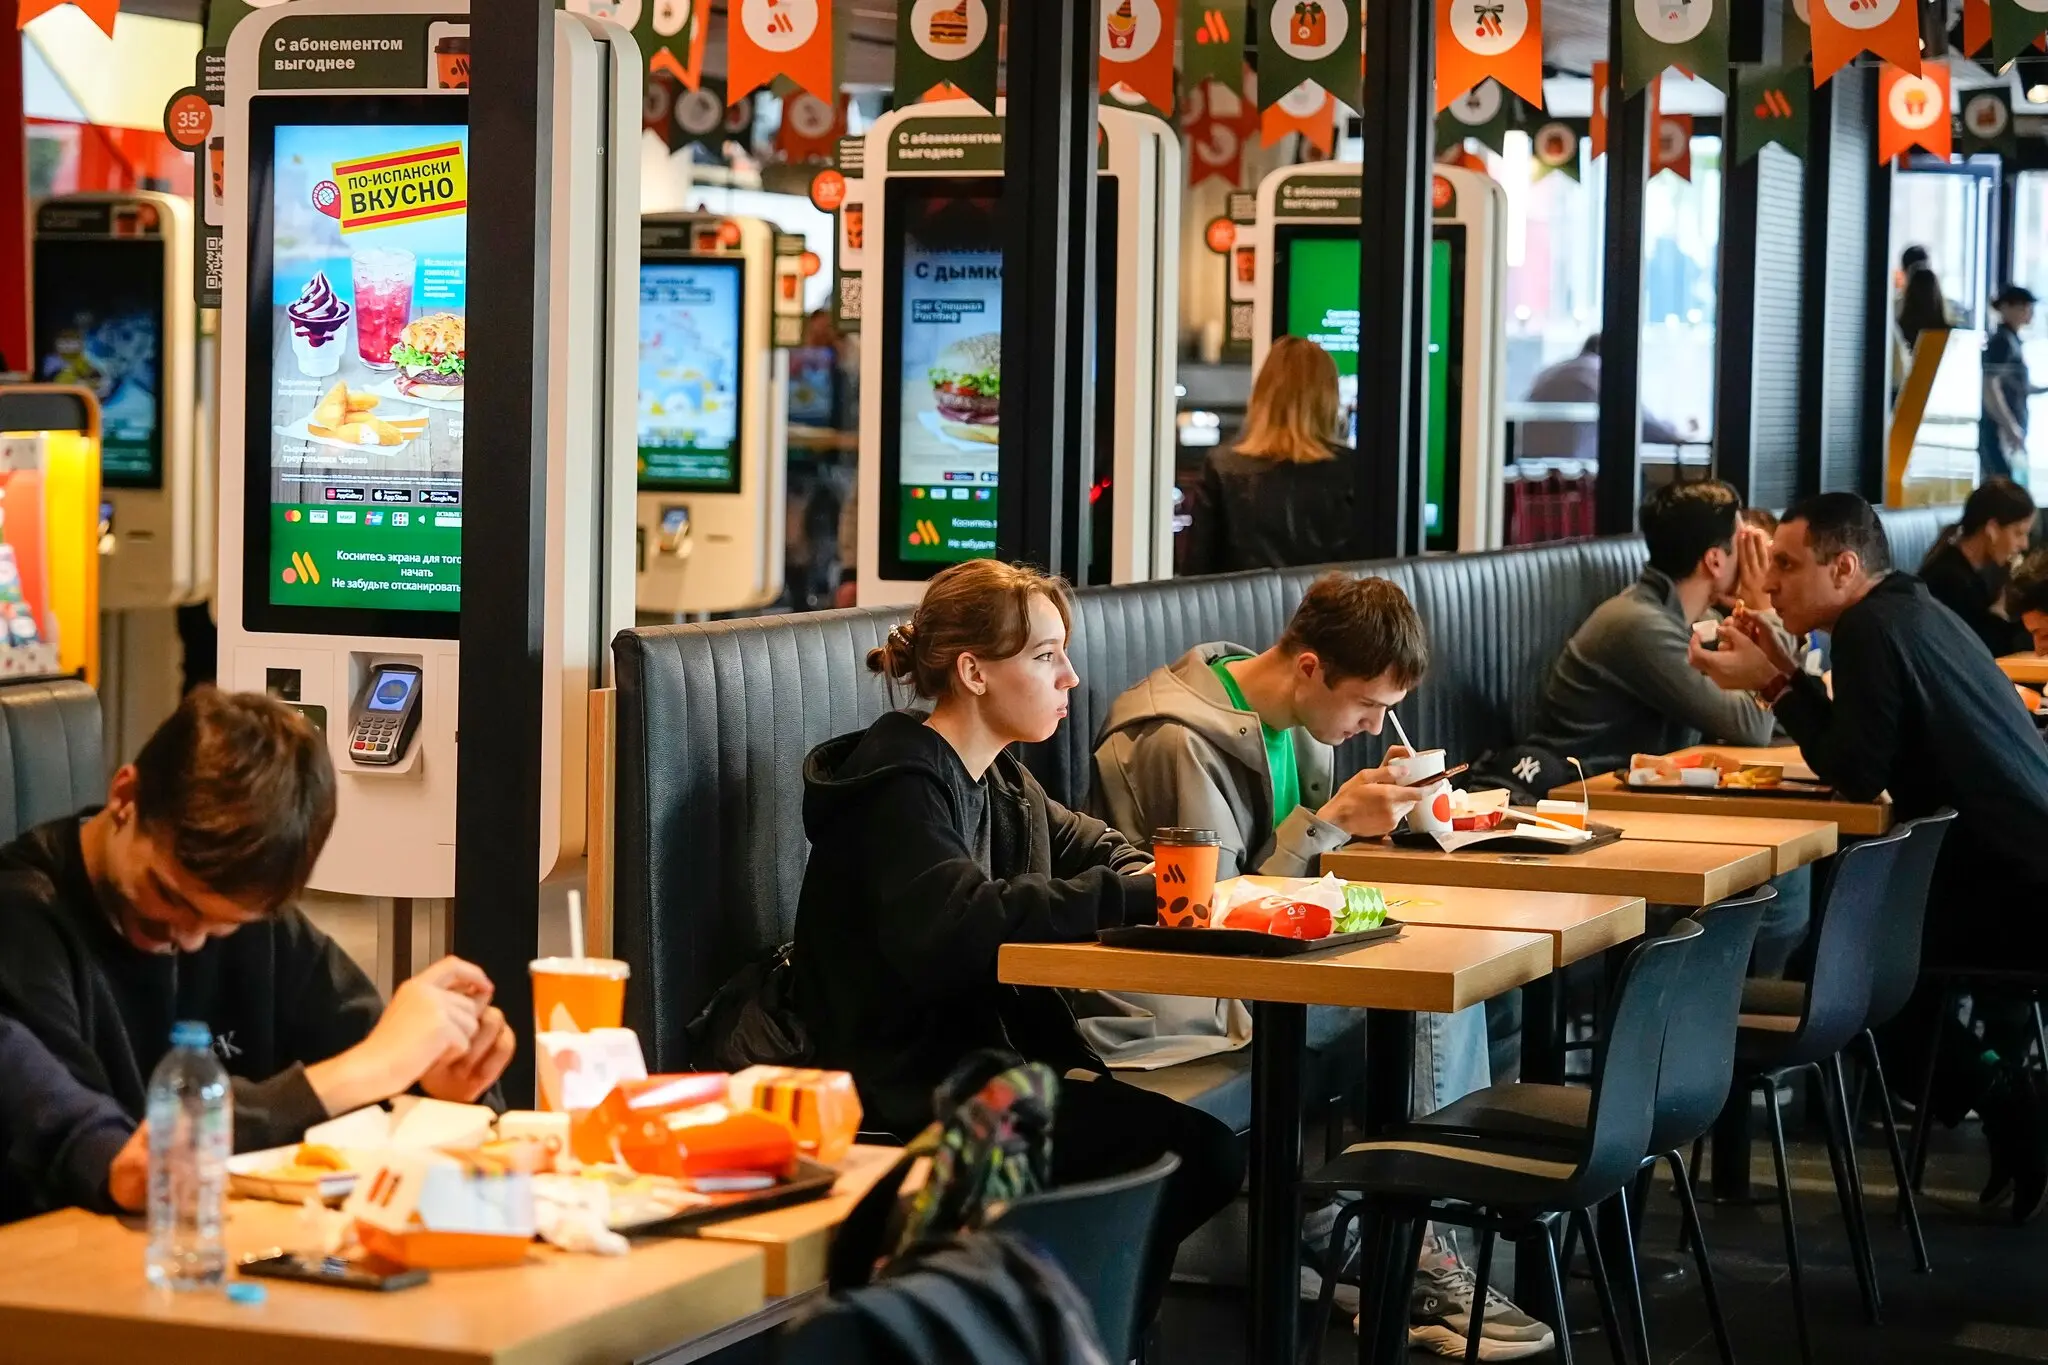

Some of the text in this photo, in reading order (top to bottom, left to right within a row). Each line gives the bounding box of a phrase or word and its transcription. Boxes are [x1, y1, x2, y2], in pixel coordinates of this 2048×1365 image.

[274, 37, 403, 52] С абонементом
[274, 57, 356, 72] выгоднее
[348, 161, 451, 190] ПО-ИСПАНСКИ
[350, 177, 454, 214] ВКУСНО
[915, 261, 929, 279] С
[336, 550, 386, 561] Коснитесь
[387, 553, 421, 564] экрана
[422, 554, 440, 564] для
[400, 567, 434, 577] начать
[331, 577, 461, 593] Не забудьте отсканировать
